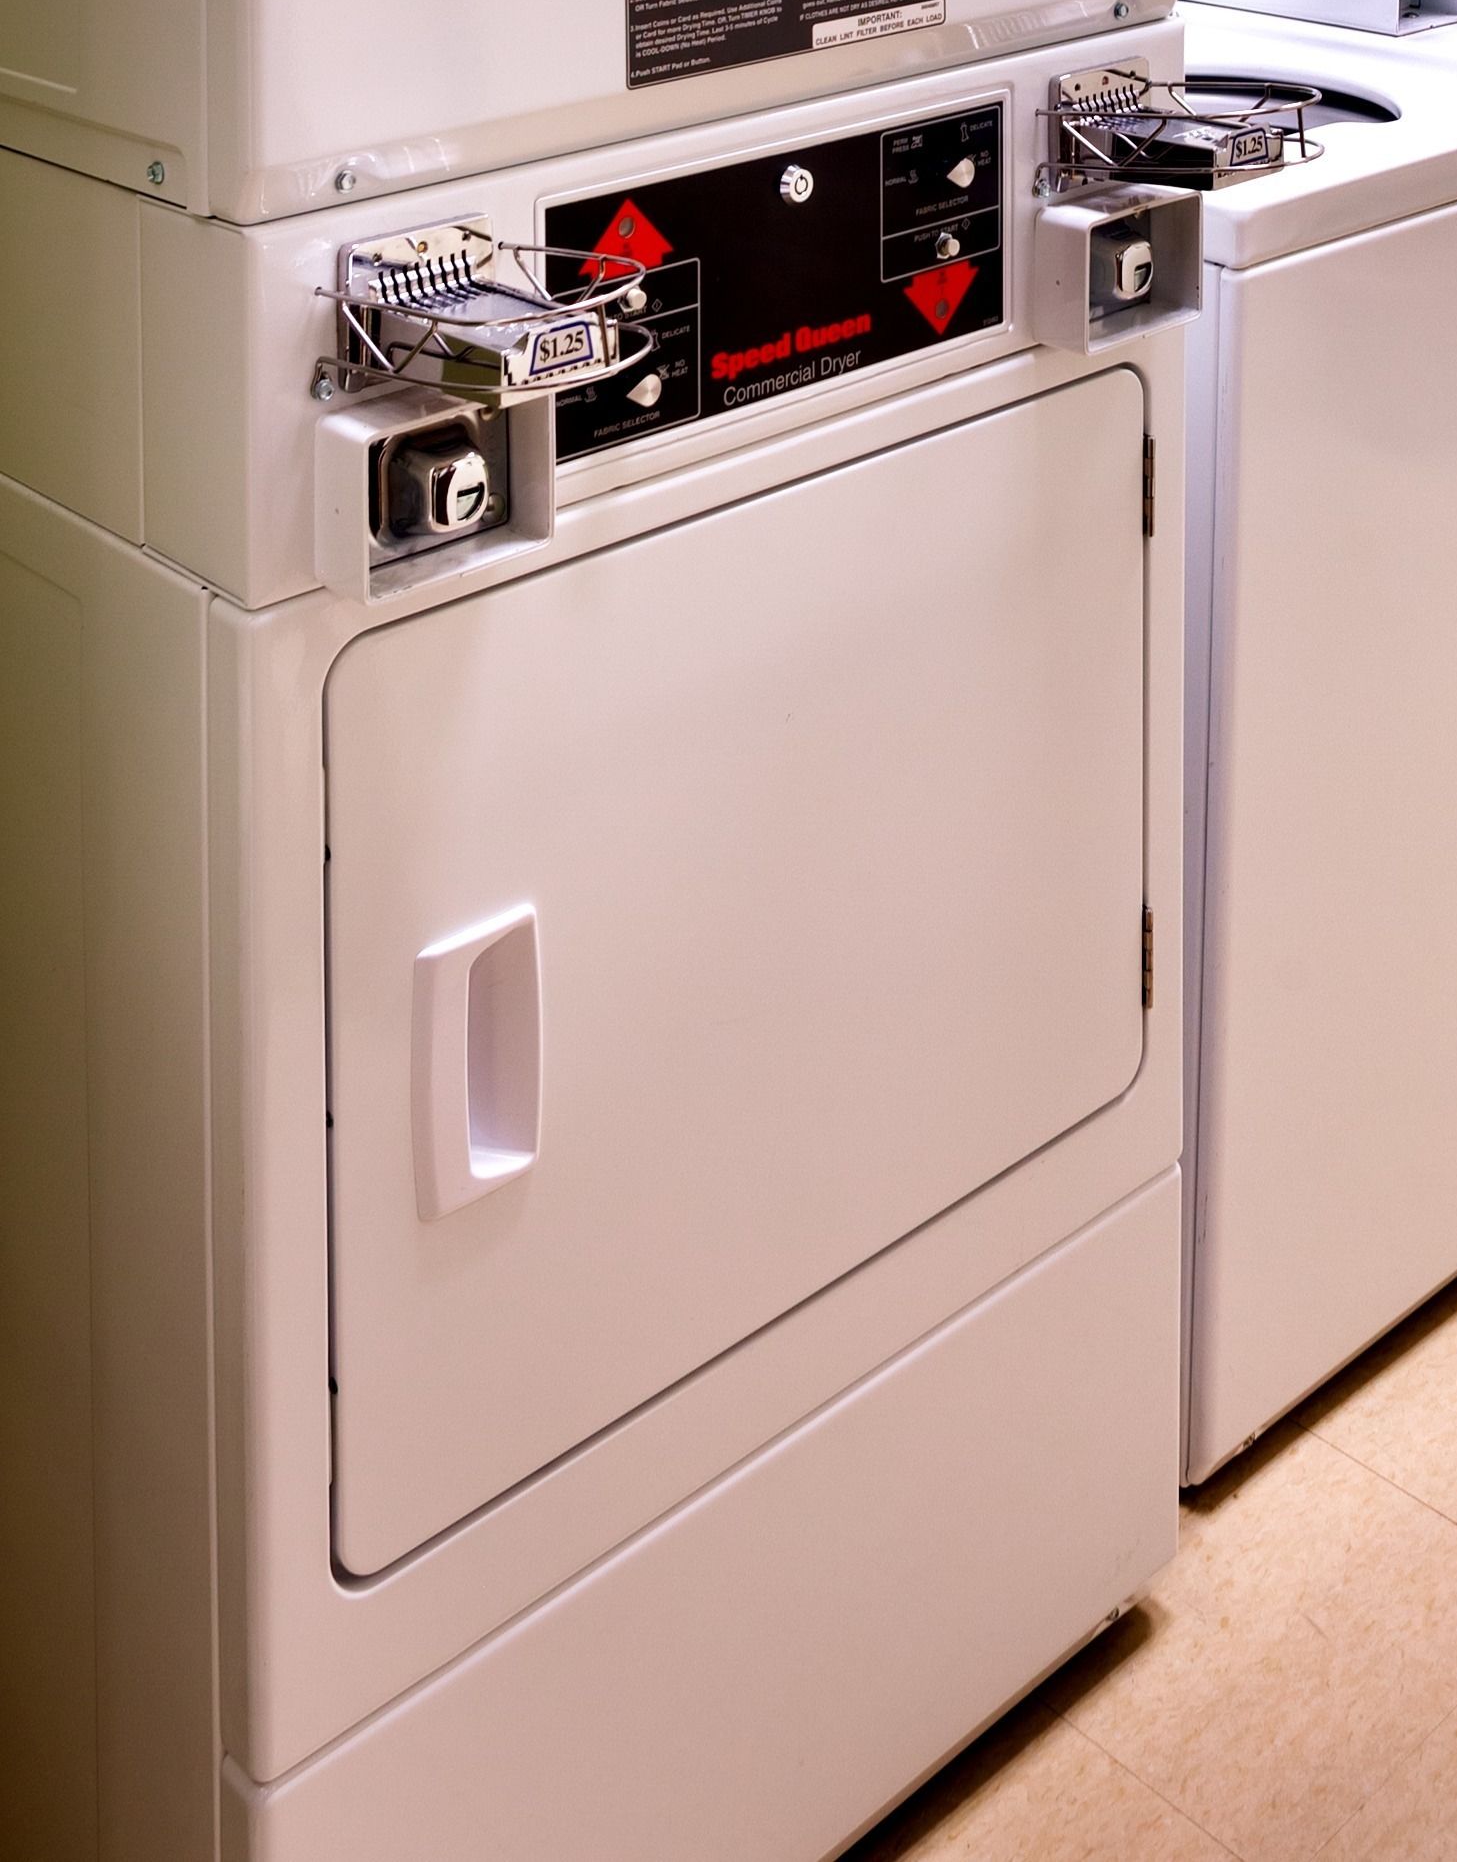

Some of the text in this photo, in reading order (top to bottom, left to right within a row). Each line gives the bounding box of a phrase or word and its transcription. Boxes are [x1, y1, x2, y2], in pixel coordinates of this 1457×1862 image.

[815, 34, 836, 45] CLEAN
[856, 26, 876, 37] FILTER
[879, 21, 903, 32] BEFORE
[907, 17, 923, 26] EACH
[926, 13, 942, 22] LOAD
[1236, 136, 1263, 159] $1.25
[977, 157, 992, 167] HEAT
[916, 195, 969, 216] FABRIC SELECTOR
[914, 224, 959, 242] PUSH TO START
[662, 325, 690, 339] DELICATE
[540, 331, 584, 362] $1.25
[711, 313, 871, 379] Speed Queen
[672, 367, 689, 378] HEAT
[674, 359, 686, 368] NO
[723, 350, 861, 406] Commercial Dryer
[594, 411, 661, 437] FABRIC SELECTOR
